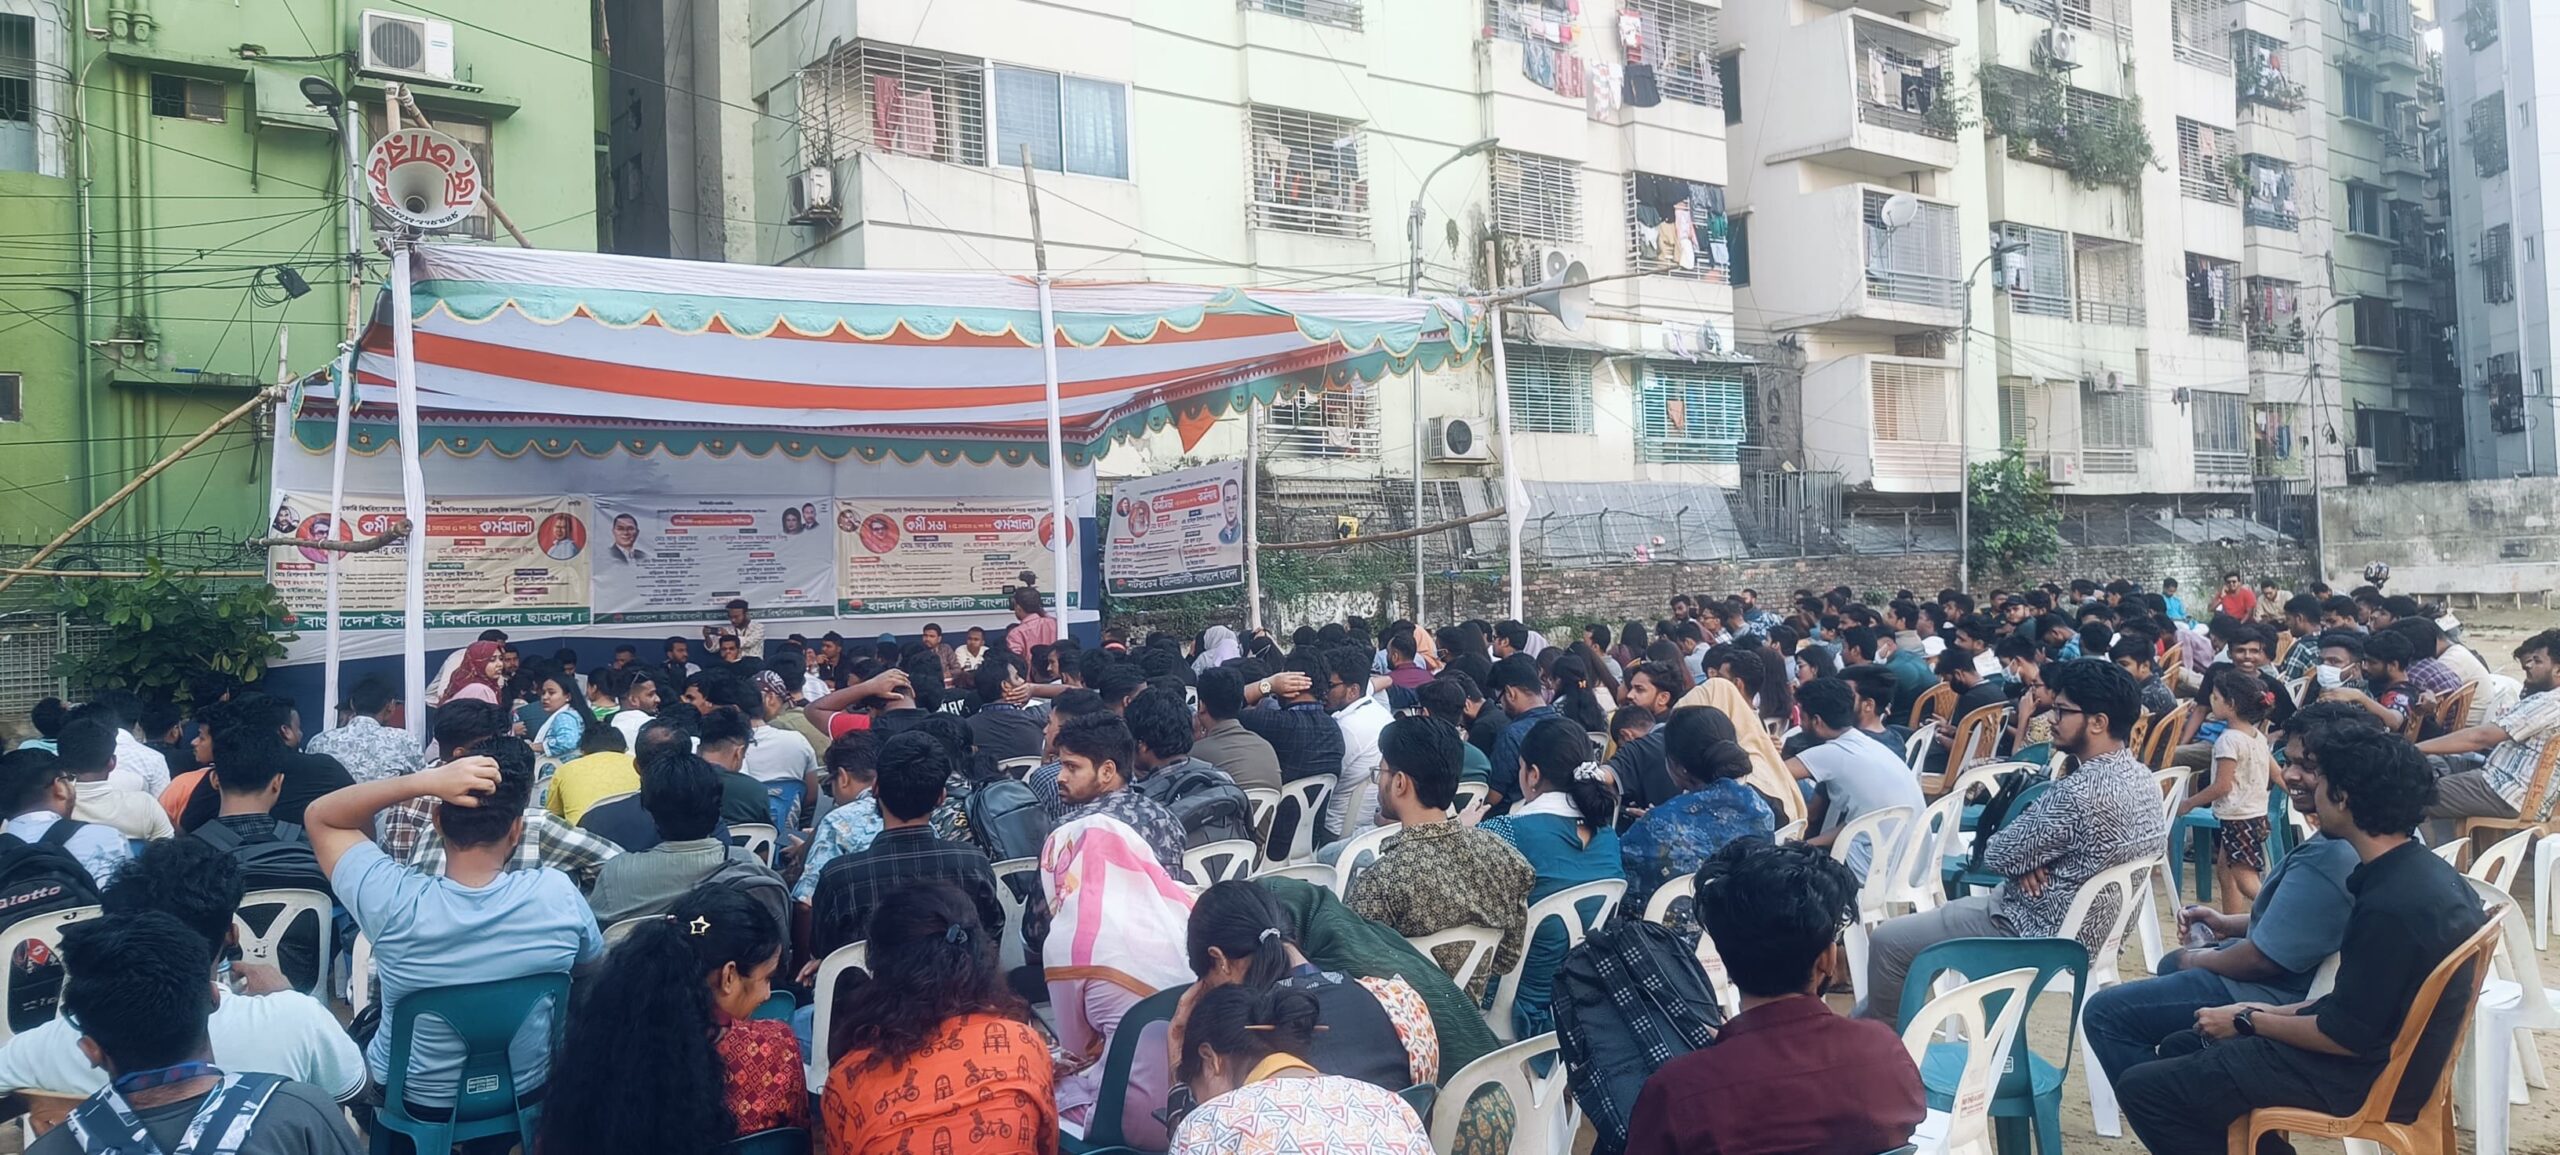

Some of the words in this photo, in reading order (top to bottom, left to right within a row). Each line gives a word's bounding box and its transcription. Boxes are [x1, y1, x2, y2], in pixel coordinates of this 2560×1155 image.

[479, 516, 533, 534] কর্মশালা
[993, 515, 1033, 530] কর্মশালা
[867, 599, 906, 612] হামদর্দ
[979, 597, 1010, 608] বাংলা
[303, 615, 377, 628] বাংাদেশ
[442, 611, 522, 625] বিশ্ববিদ্যালয়
[526, 612, 572, 622] ছাত্রদল
[9, 885, 62, 906] lotto
